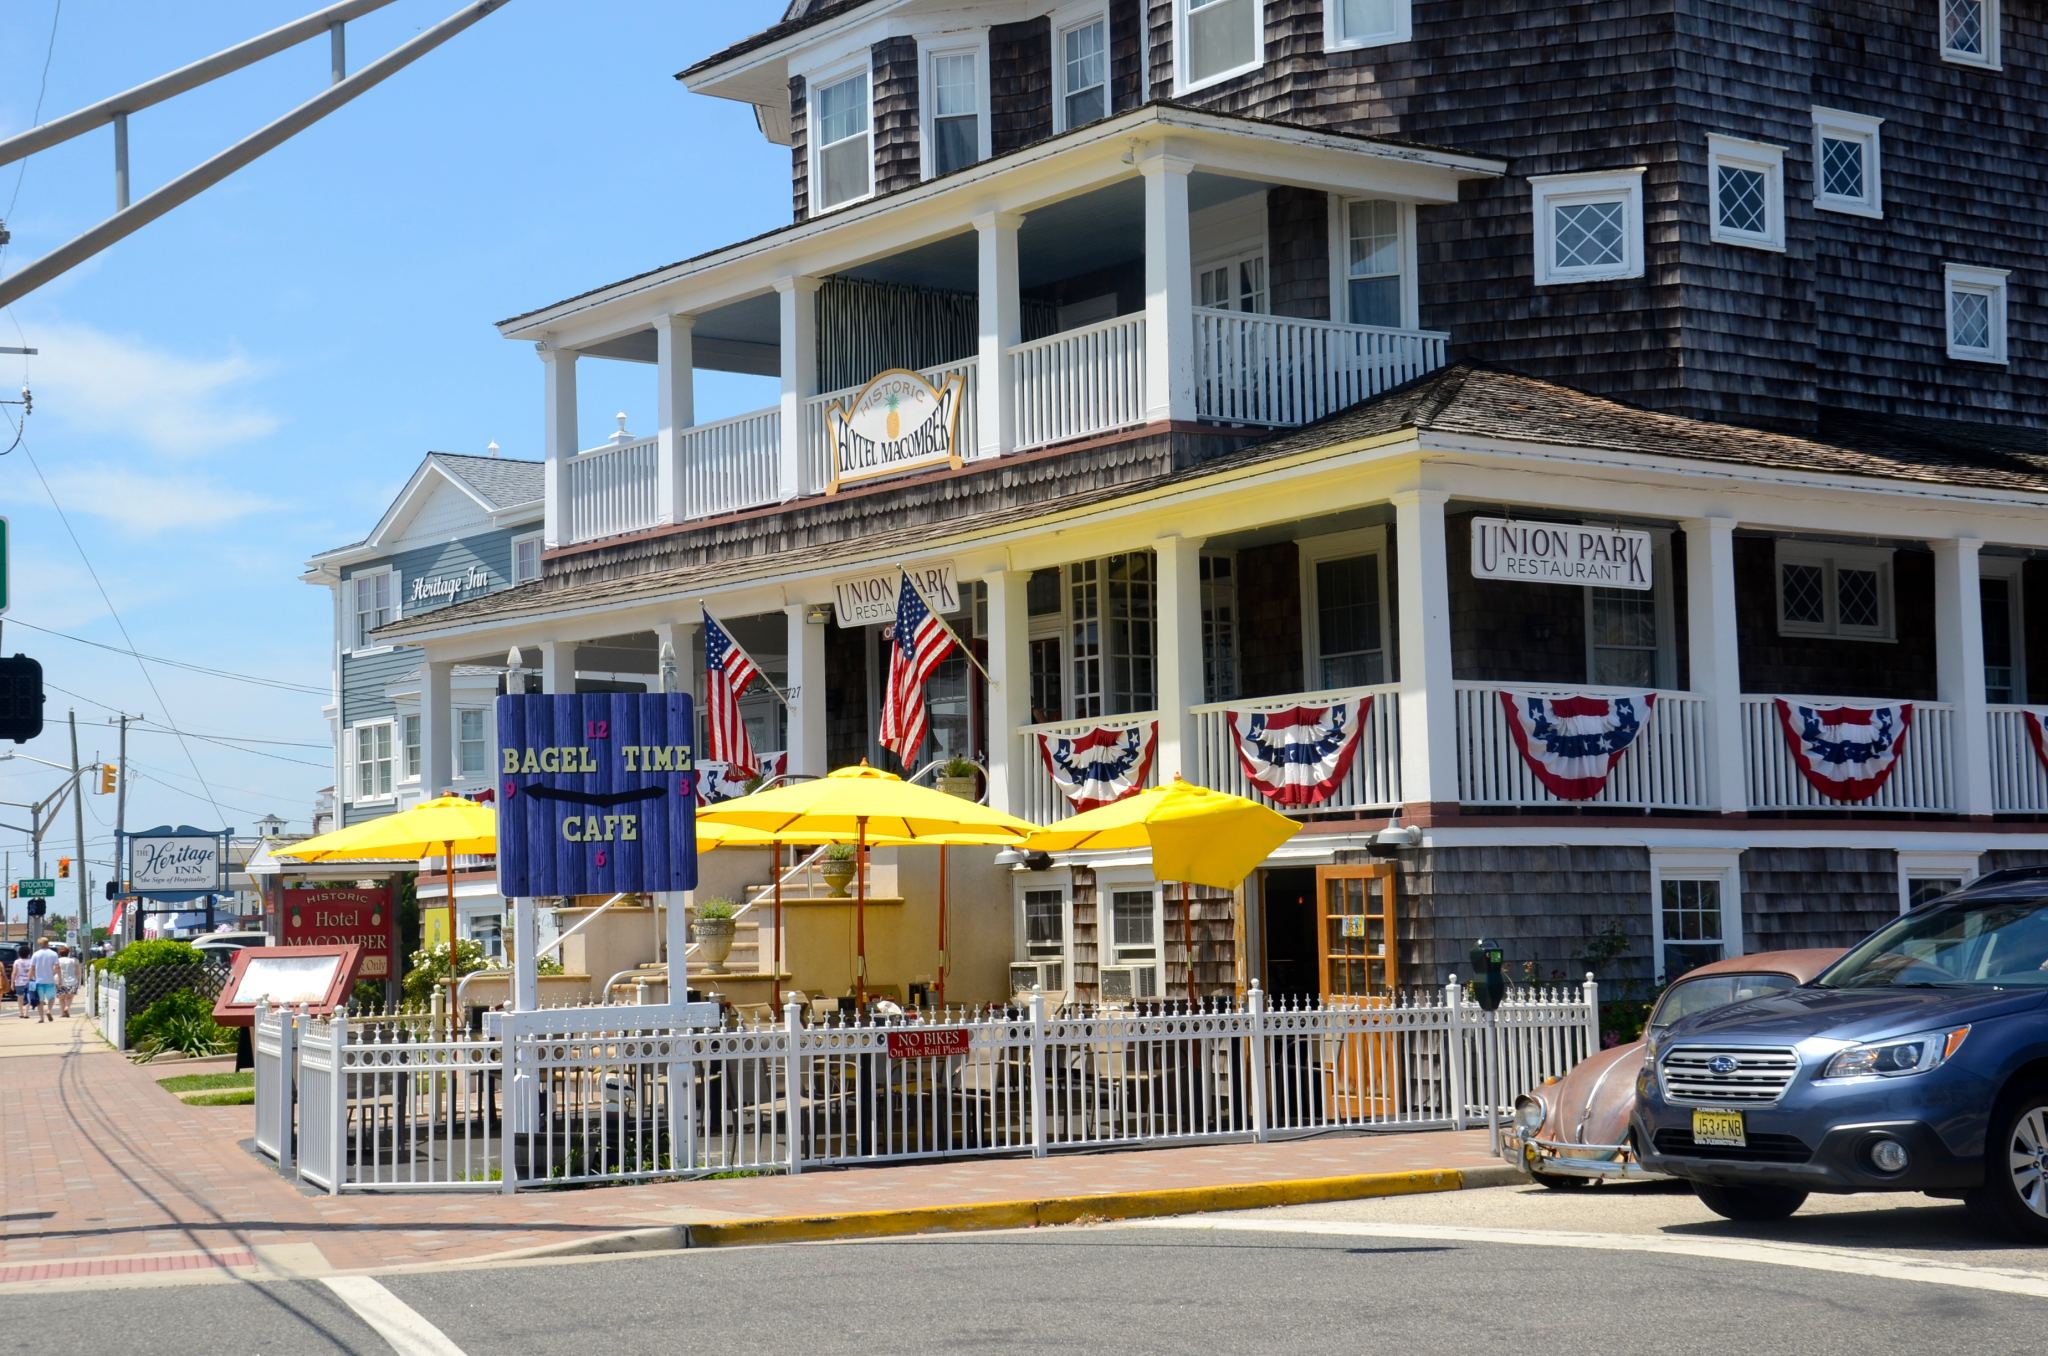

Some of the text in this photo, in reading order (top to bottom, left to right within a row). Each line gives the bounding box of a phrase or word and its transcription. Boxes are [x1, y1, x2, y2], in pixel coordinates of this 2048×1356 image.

[860, 381, 925, 416] HISTORIC
[838, 388, 951, 473] HOTEL MACOMBER
[1481, 525, 1646, 582] UNION PARK
[1507, 557, 1621, 581] RESTAURANT
[411, 566, 489, 602] Heritage Inn
[836, 567, 956, 622] UNION ARK
[587, 720, 609, 739] 12
[503, 746, 692, 774] BAGEL TIME
[505, 781, 517, 798] 9
[680, 778, 691, 797] 3
[562, 815, 637, 842] CAFE
[135, 842, 216, 878] Heritage
[594, 850, 607, 868] 6
[175, 866, 202, 874] INN
[21, 881, 54, 889] STOCKTON
[27, 888, 48, 896] PLACE
[306, 892, 369, 904] HISTORIC
[315, 910, 360, 927] Hotel
[366, 959, 386, 973] Only
[899, 1031, 960, 1047] NO BIKES
[889, 1045, 969, 1058] On The Rail Please
